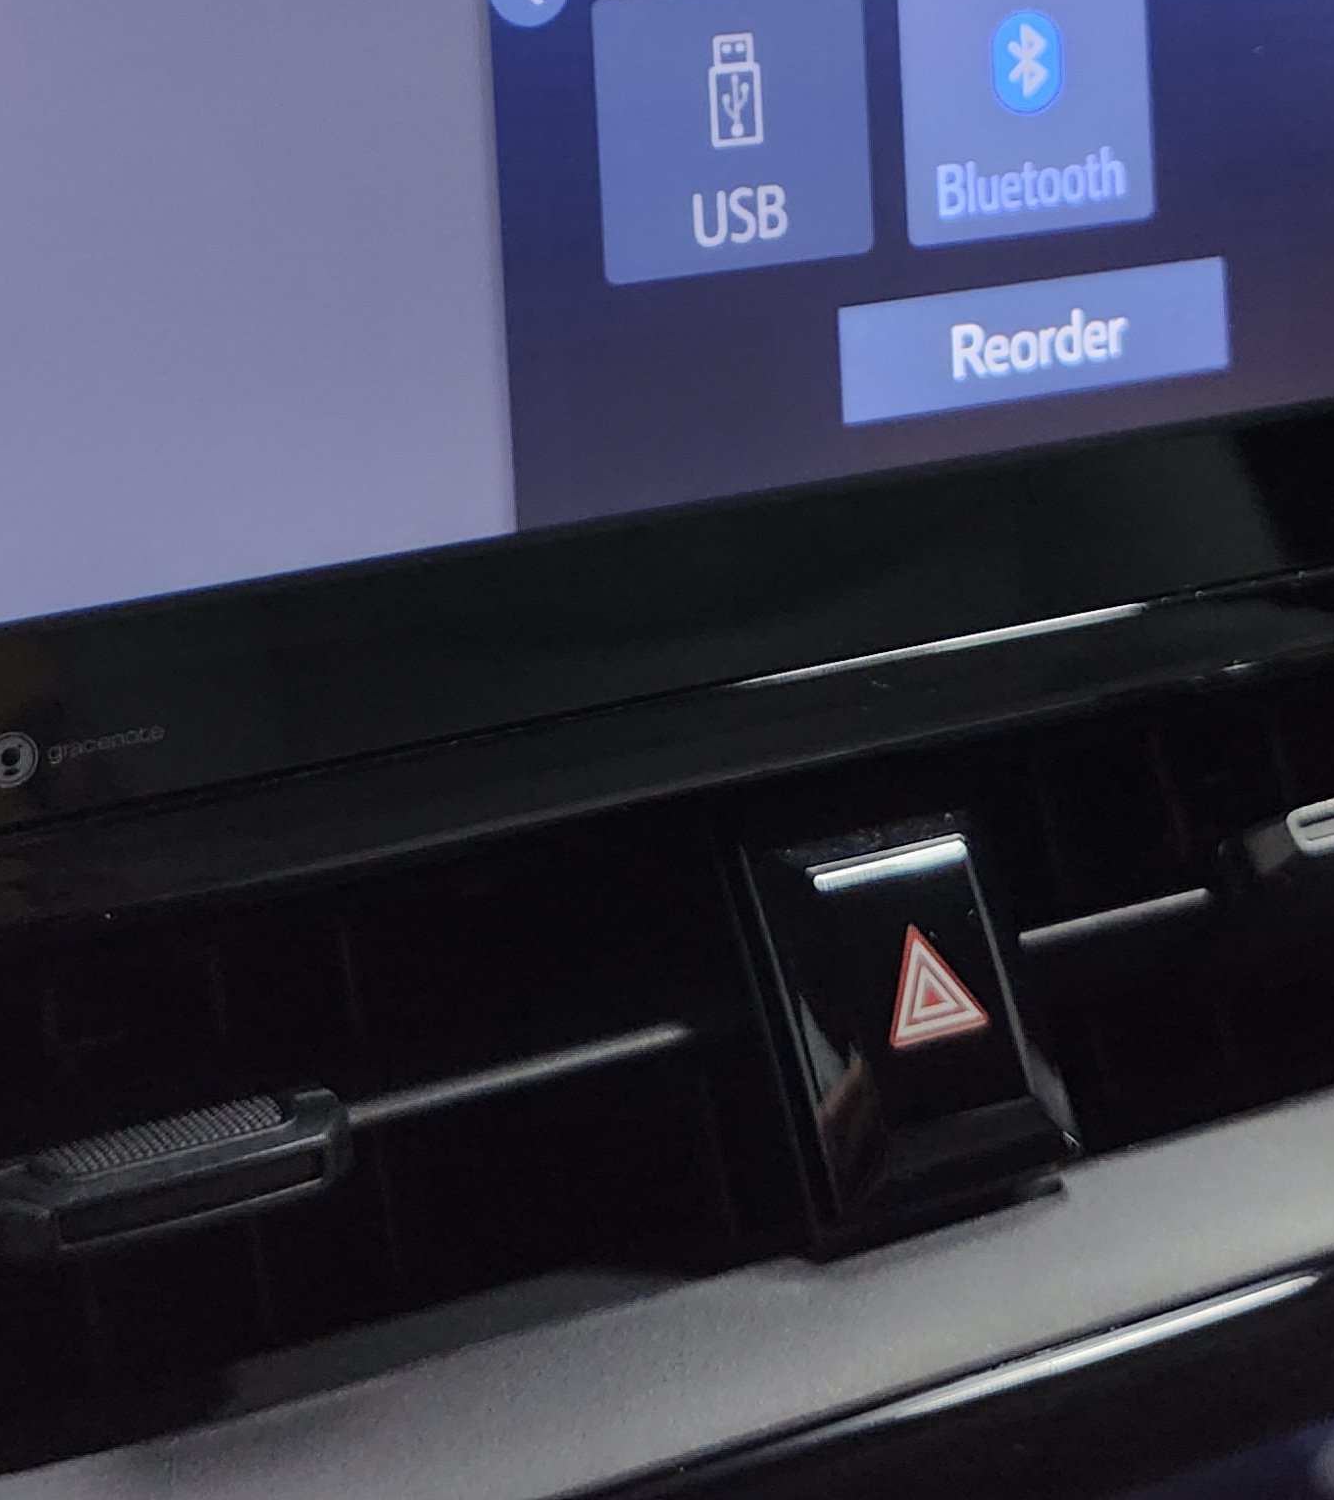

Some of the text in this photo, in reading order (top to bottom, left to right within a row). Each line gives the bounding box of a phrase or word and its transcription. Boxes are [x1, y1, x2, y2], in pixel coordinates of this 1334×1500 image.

[692, 184, 788, 248] USB
[937, 146, 1126, 220] Bluetooth
[951, 307, 1129, 381] Reorder
[46, 723, 166, 765] gracenote
